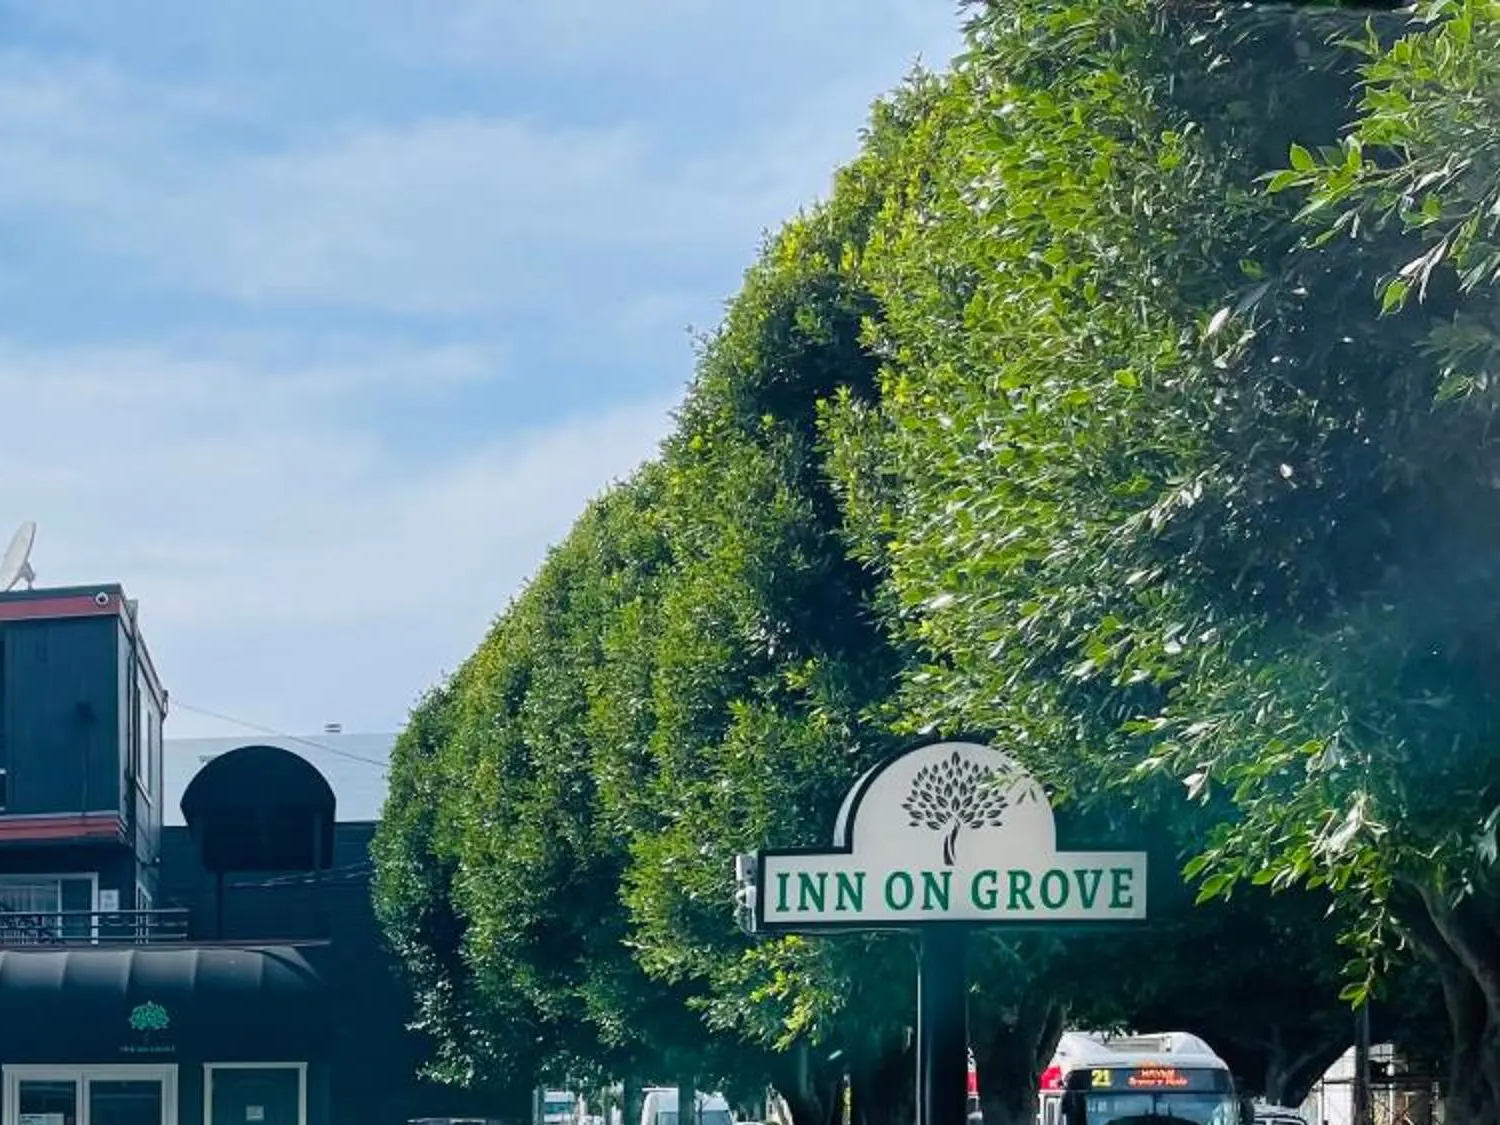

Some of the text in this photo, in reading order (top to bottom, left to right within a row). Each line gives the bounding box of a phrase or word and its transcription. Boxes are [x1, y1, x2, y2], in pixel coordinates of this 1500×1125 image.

[775, 867, 1134, 912] INN ON GROVE
[1091, 1069, 1112, 1087] 21
